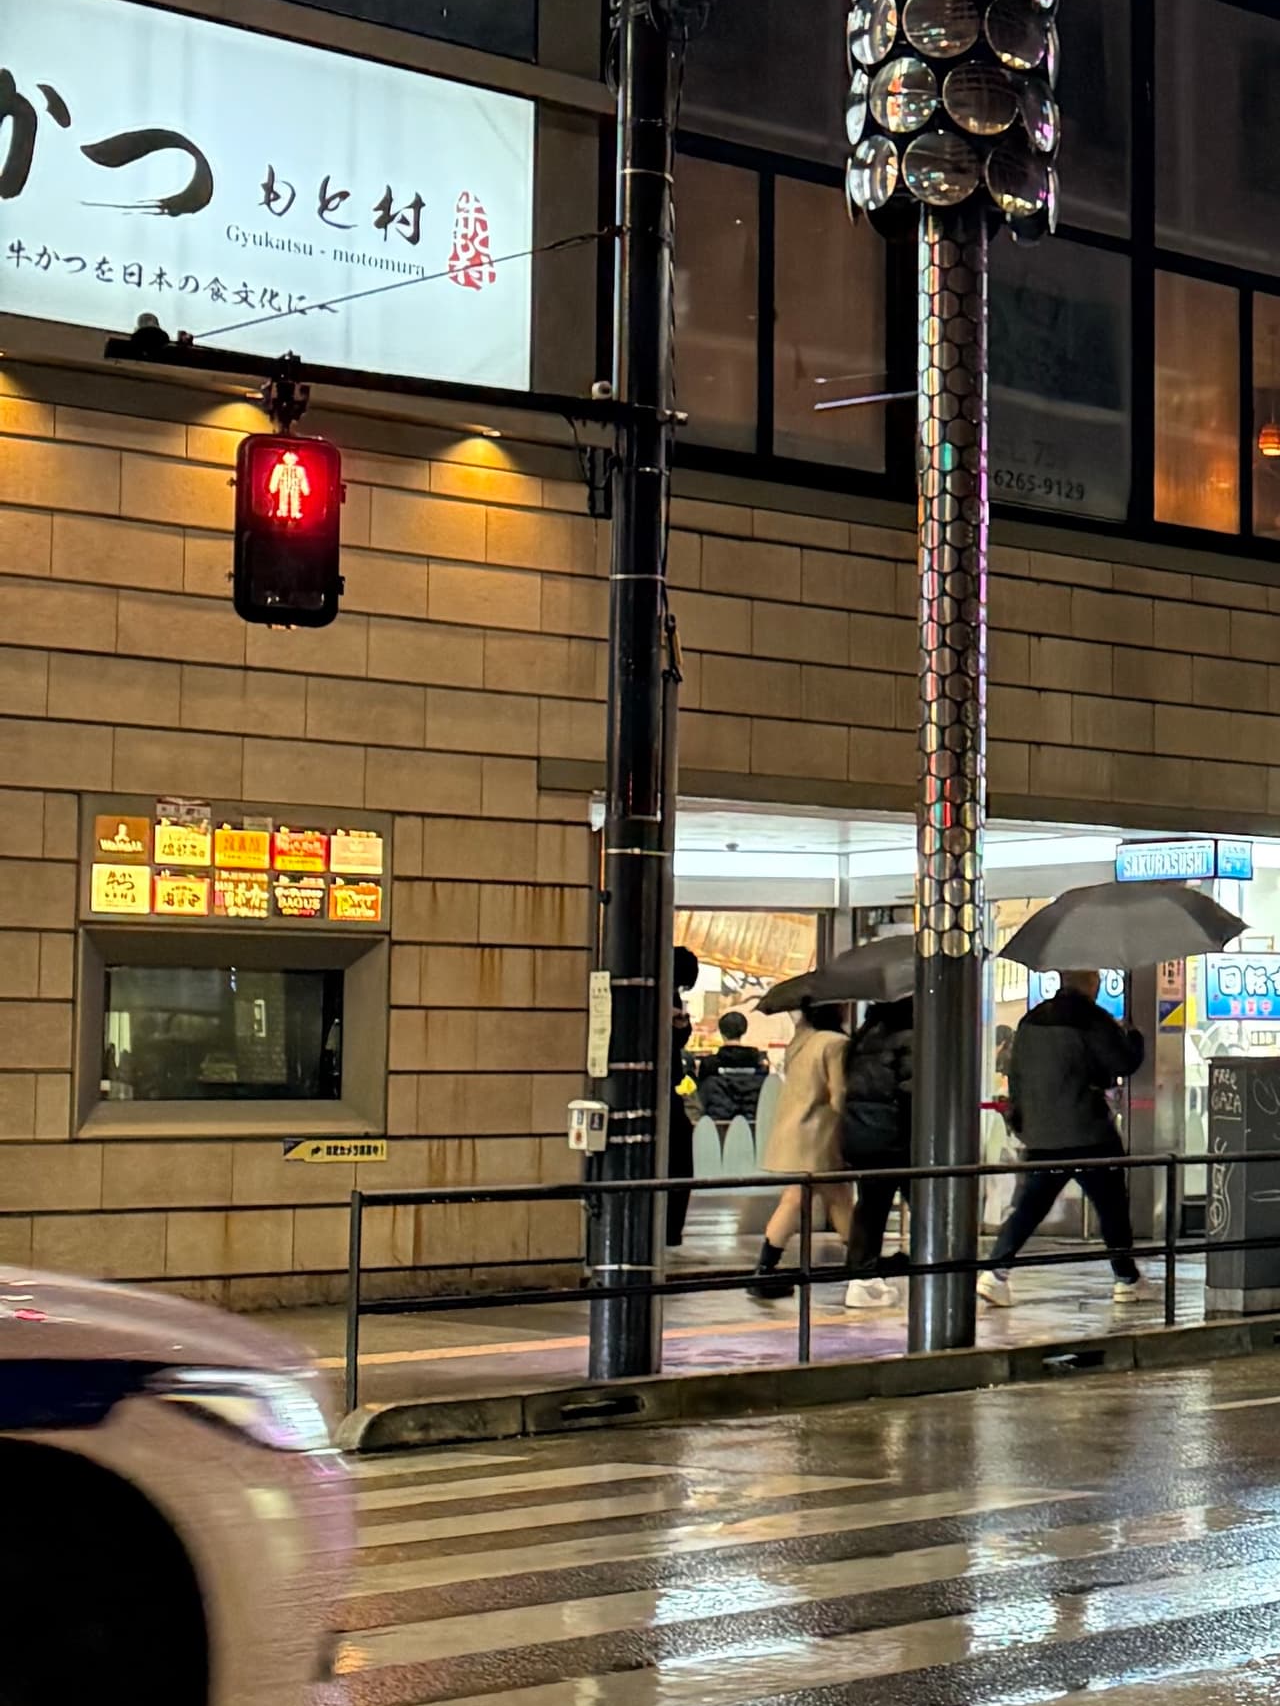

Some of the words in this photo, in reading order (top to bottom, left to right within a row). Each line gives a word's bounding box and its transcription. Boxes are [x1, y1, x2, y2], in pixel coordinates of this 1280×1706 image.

[258, 164, 426, 245] もと村
[226, 223, 315, 257] Gyukatsu
[332, 247, 427, 279] motomura
[1123, 852, 1210, 878] SAKURASUSHI
